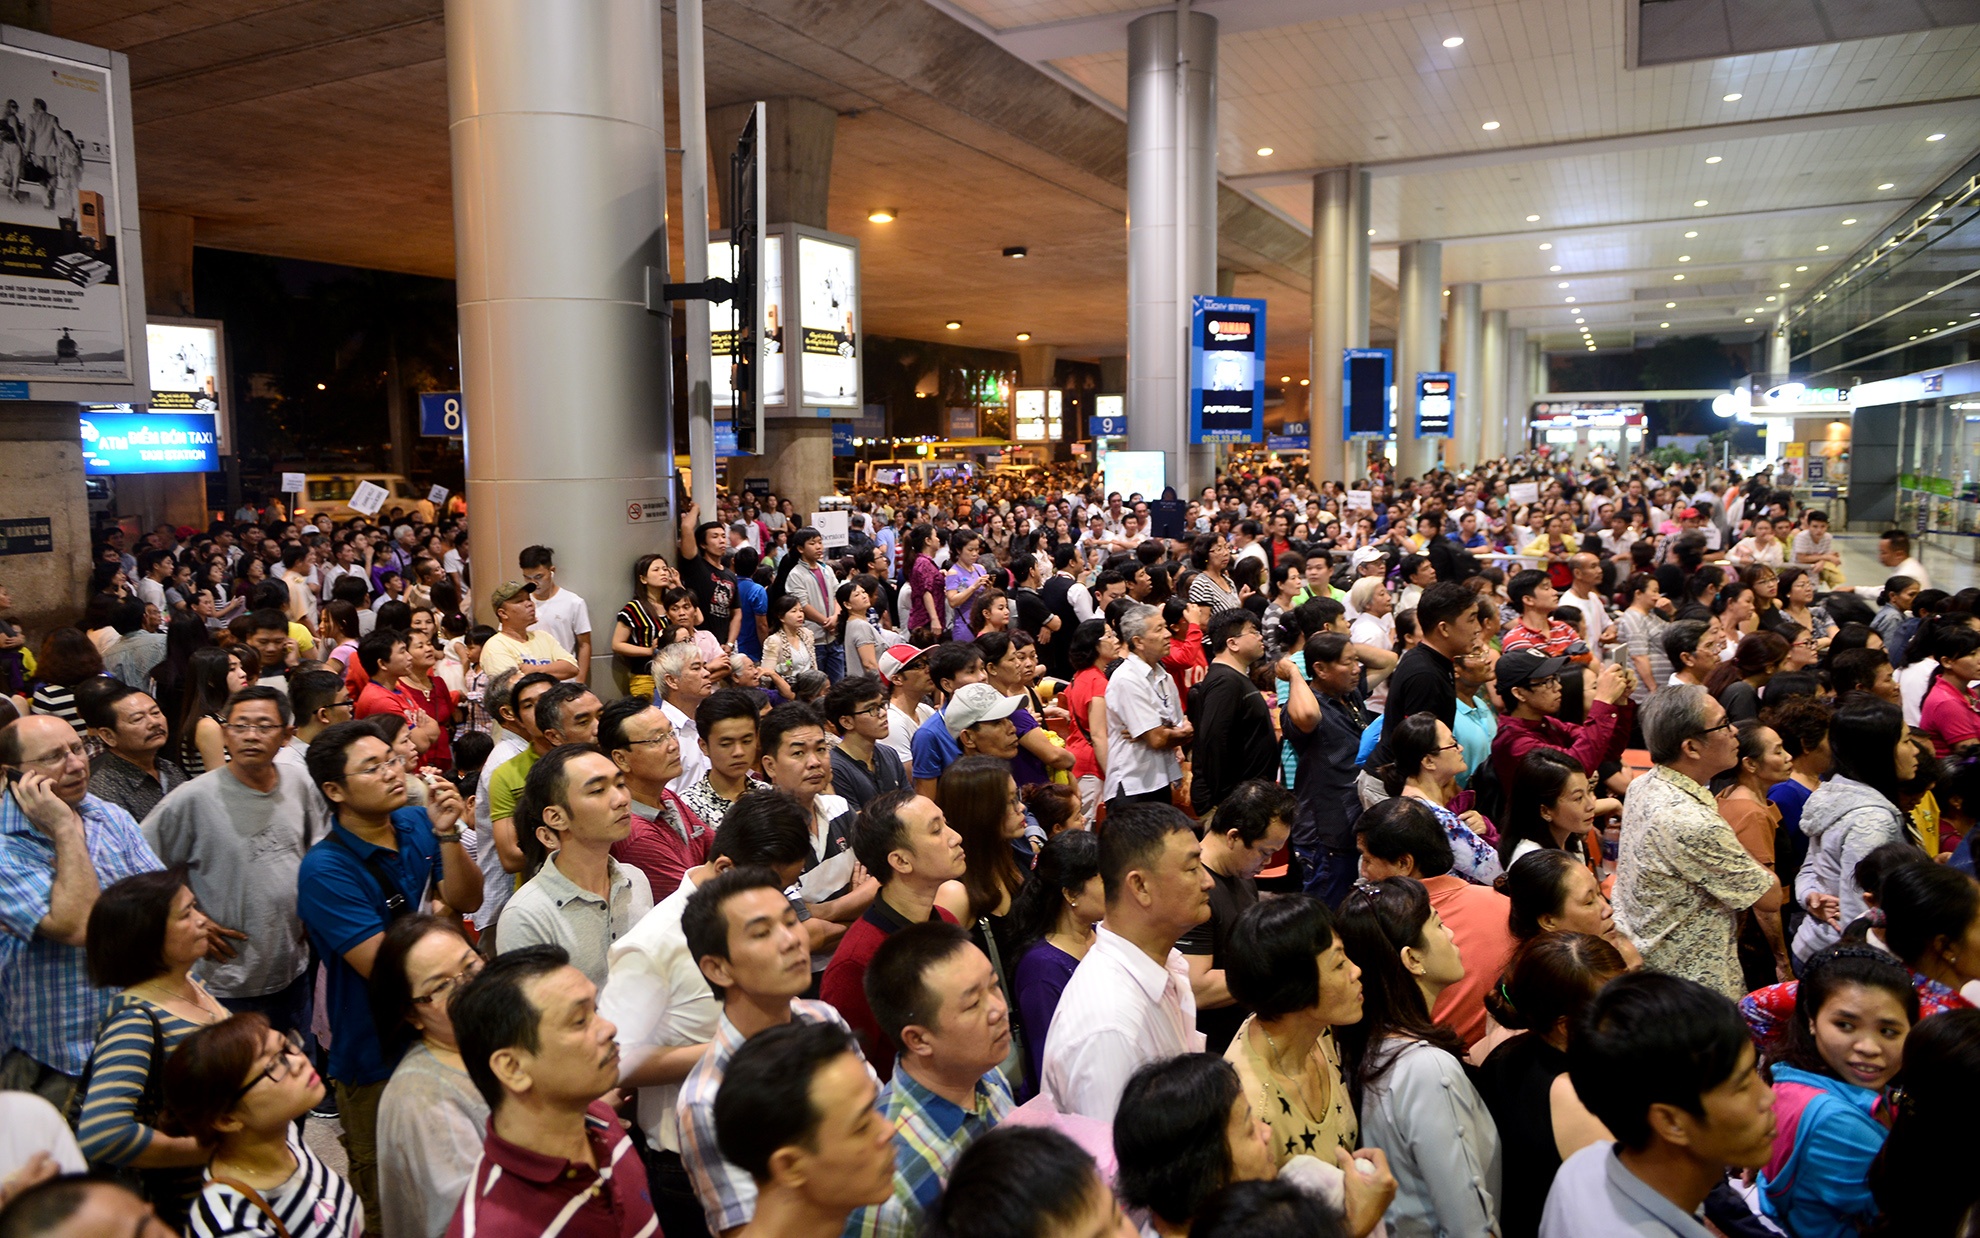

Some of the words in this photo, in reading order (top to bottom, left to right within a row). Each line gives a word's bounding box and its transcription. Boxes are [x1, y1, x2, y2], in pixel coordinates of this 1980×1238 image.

[1219, 321, 1251, 335] YAMAHA
[444, 398, 460, 430] 8
[1102, 418, 1113, 433] 9
[1289, 423, 1303, 435] 10
[98, 436, 128, 450] ATM
[188, 432, 213, 444] TAXI
[164, 450, 206, 461] STATION
